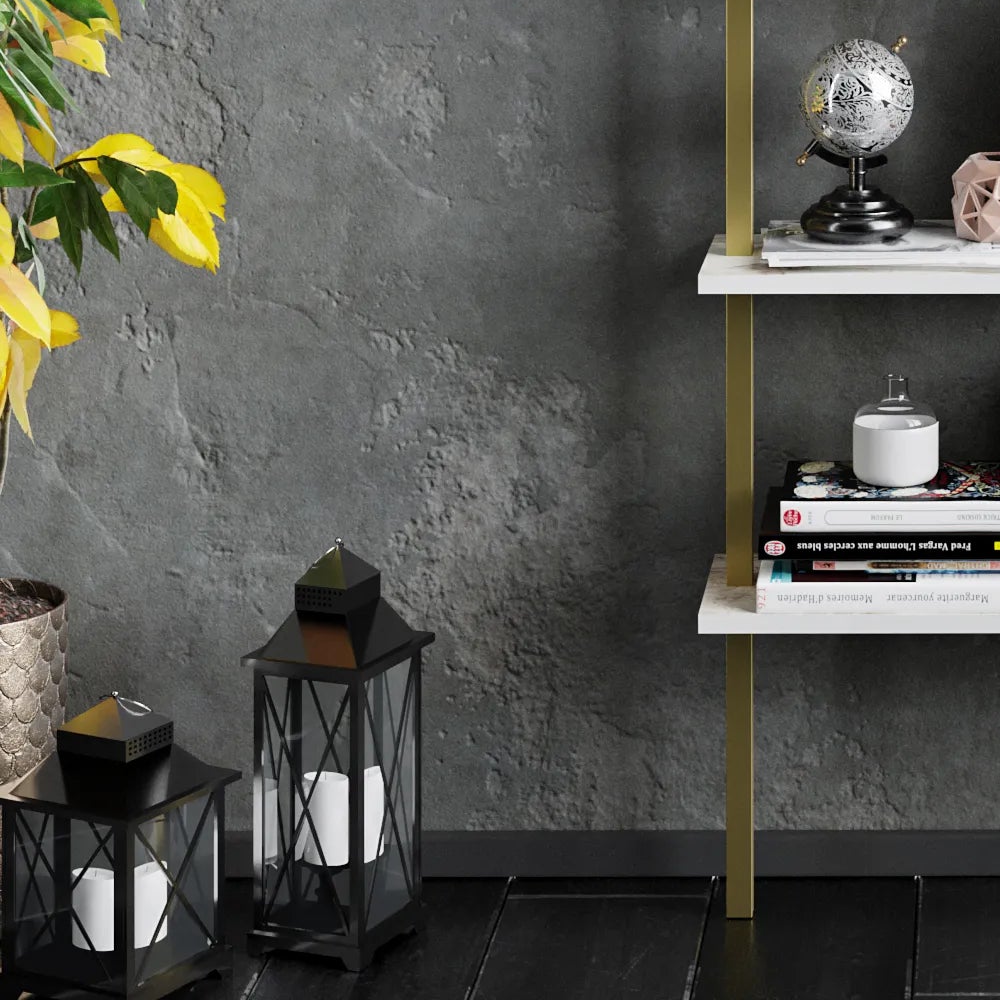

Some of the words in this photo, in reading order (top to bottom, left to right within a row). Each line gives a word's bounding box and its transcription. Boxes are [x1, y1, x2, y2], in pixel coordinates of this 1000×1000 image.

[797, 541, 821, 551] bleus
[823, 541, 855, 551] cercles
[875, 541, 916, 551] L'homme
[918, 541, 949, 551] Vargas
[950, 542, 971, 551] Fred
[777, 593, 824, 603] d'Hadrien
[827, 593, 873, 603] Memoires
[887, 593, 935, 603] yourcenar
[938, 593, 989, 603] Marguerite
